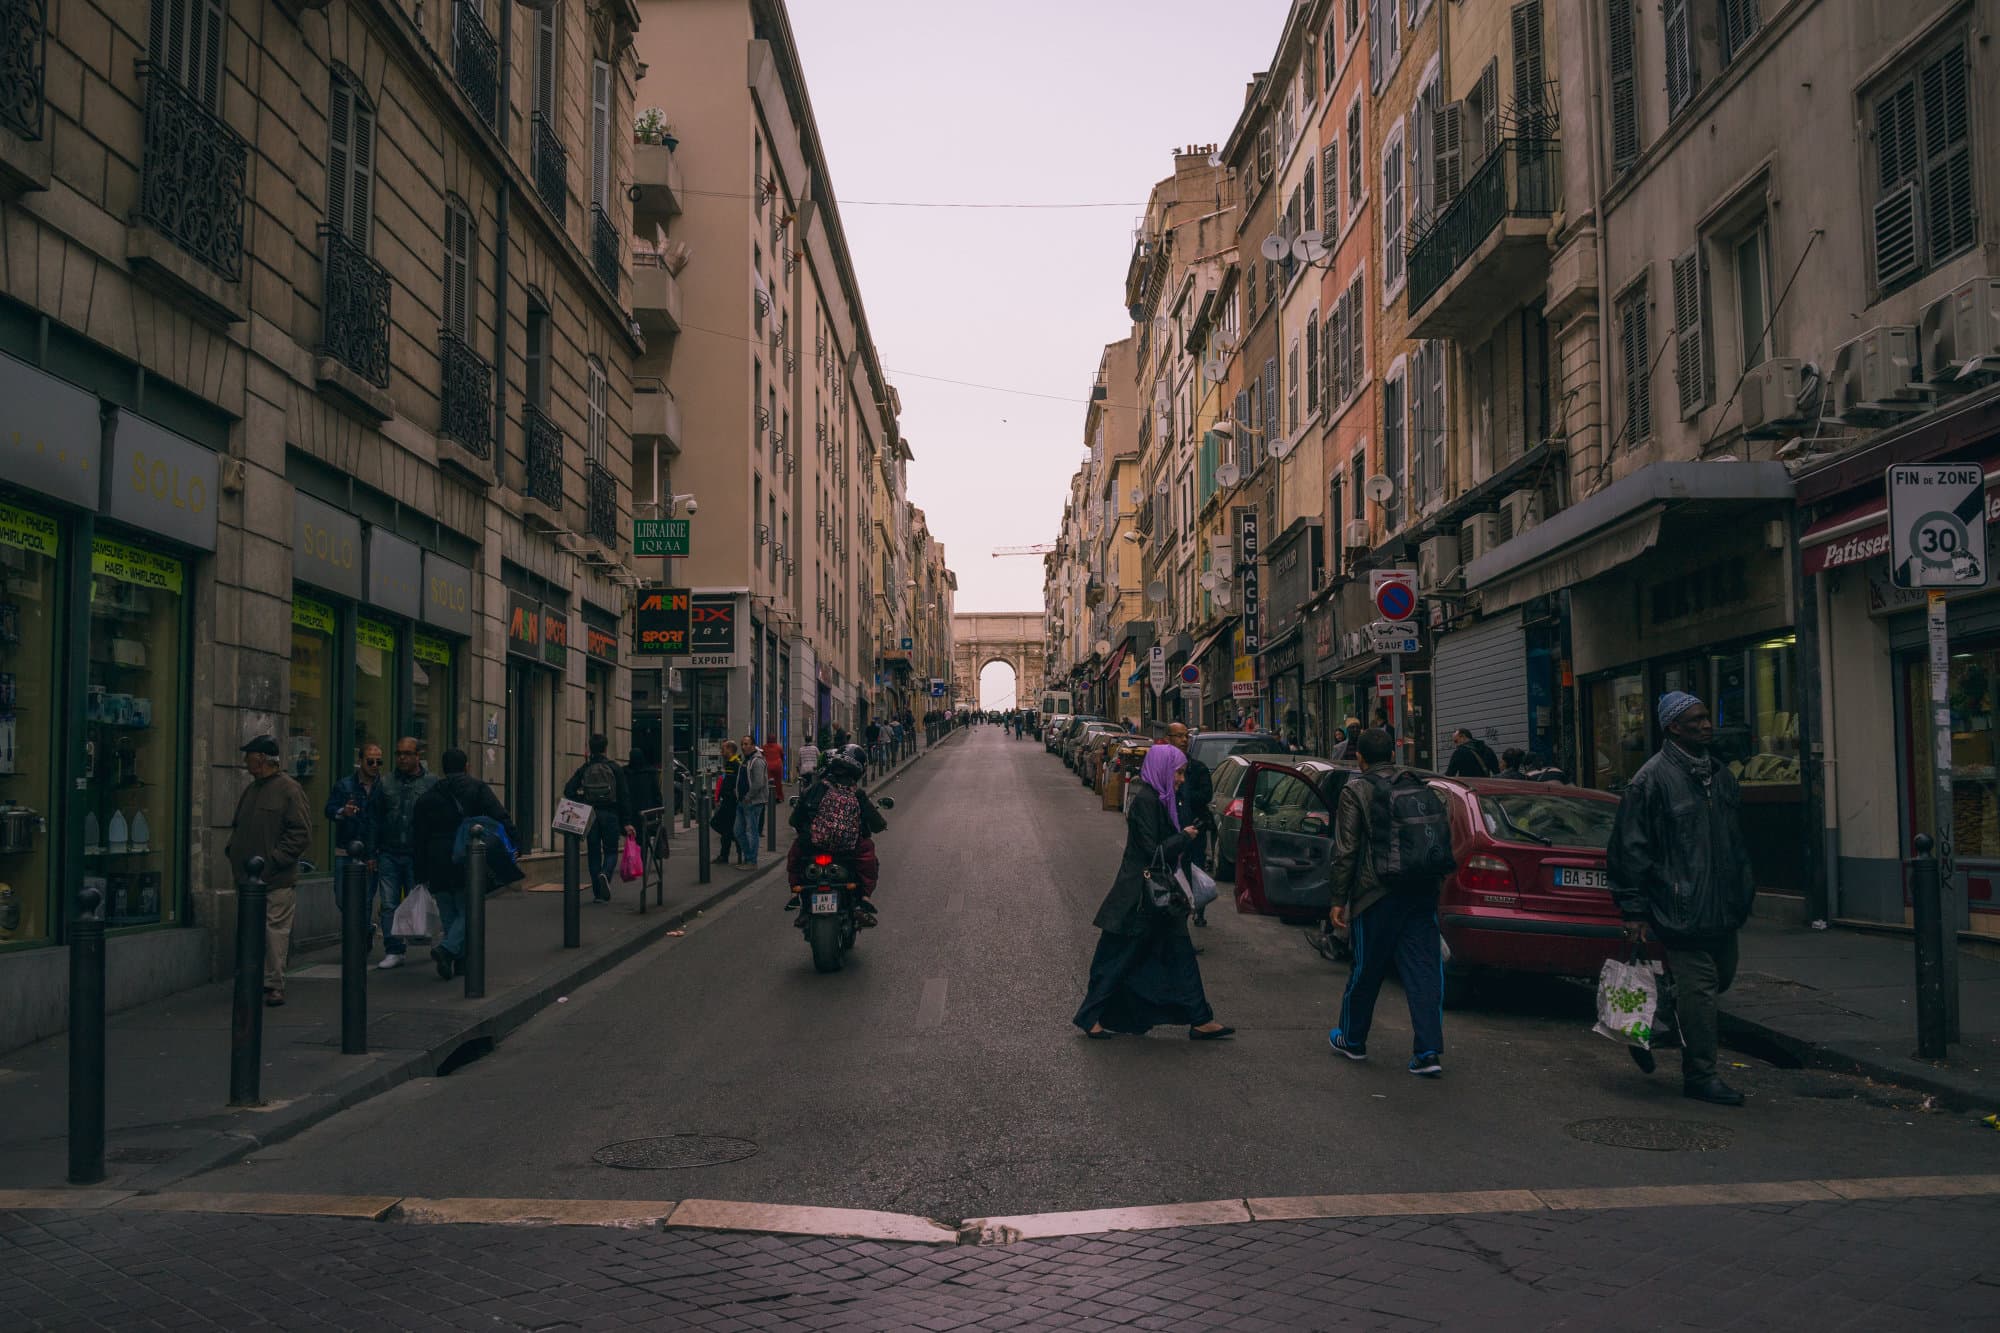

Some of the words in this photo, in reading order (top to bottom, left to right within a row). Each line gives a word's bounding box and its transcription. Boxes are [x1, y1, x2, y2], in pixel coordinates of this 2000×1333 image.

[131, 452, 206, 513] SOLO
[1895, 471, 1919, 485] FIN
[1937, 471, 1978, 485] ZONE
[0, 509, 18, 525] ONY
[636, 523, 687, 538] LIBRAIRIE
[303, 523, 353, 569] SOLO
[641, 540, 681, 552] IQRAA
[1922, 528, 1956, 553] 30
[1244, 521, 1258, 647] REVACUIR
[431, 576, 466, 613] SOLO
[639, 594, 687, 611] MSN
[509, 606, 539, 646] MSN
[642, 630, 685, 642] SPORT
[1153, 647, 1162, 660] P
[1377, 642, 1402, 650] SAUF
[691, 656, 730, 665] EXPORT
[1233, 683, 1254, 692] HOTEL
